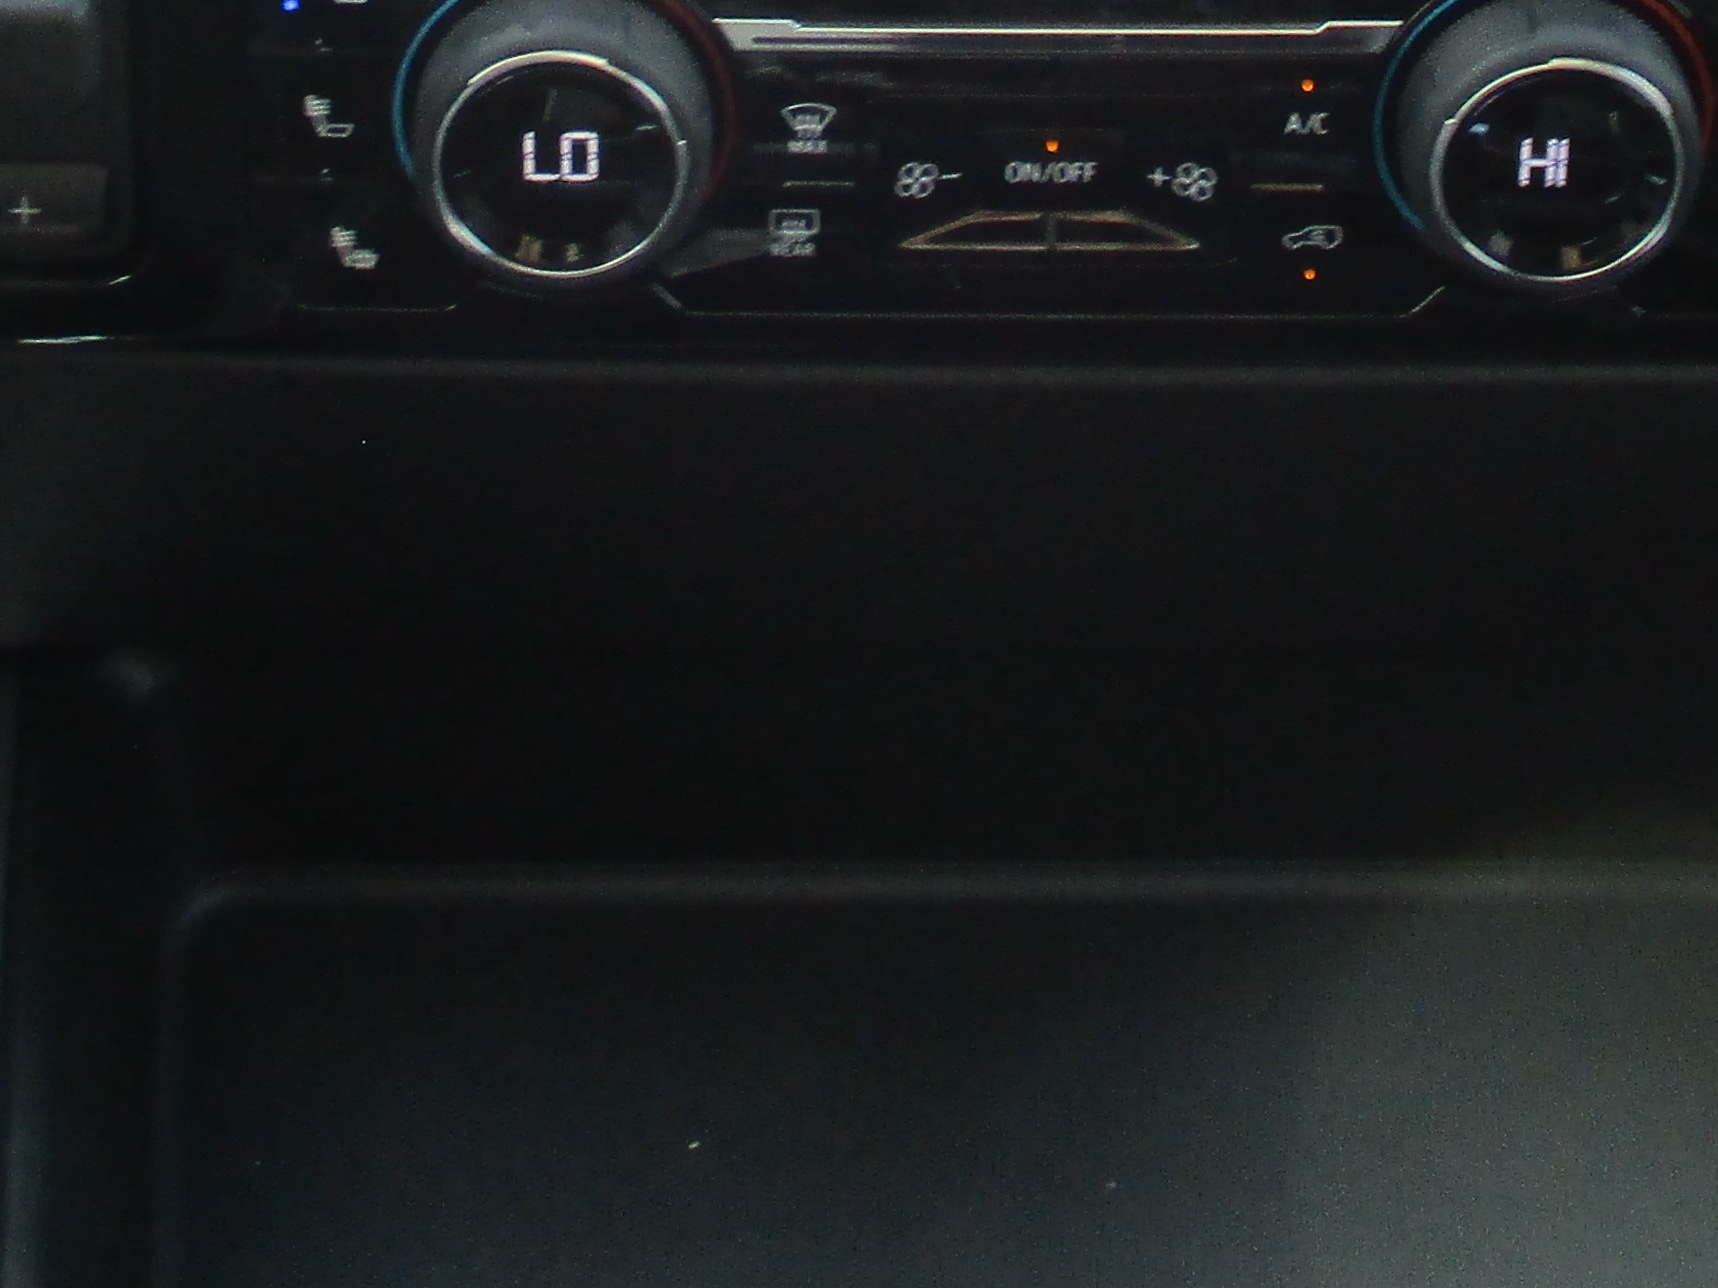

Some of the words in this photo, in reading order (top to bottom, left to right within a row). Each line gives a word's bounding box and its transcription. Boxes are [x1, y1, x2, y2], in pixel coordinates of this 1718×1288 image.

[1283, 112, 1330, 136] A/C
[521, 130, 600, 183] LO
[1004, 161, 1099, 184] ON/OFF
[1517, 136, 1572, 188] HI
